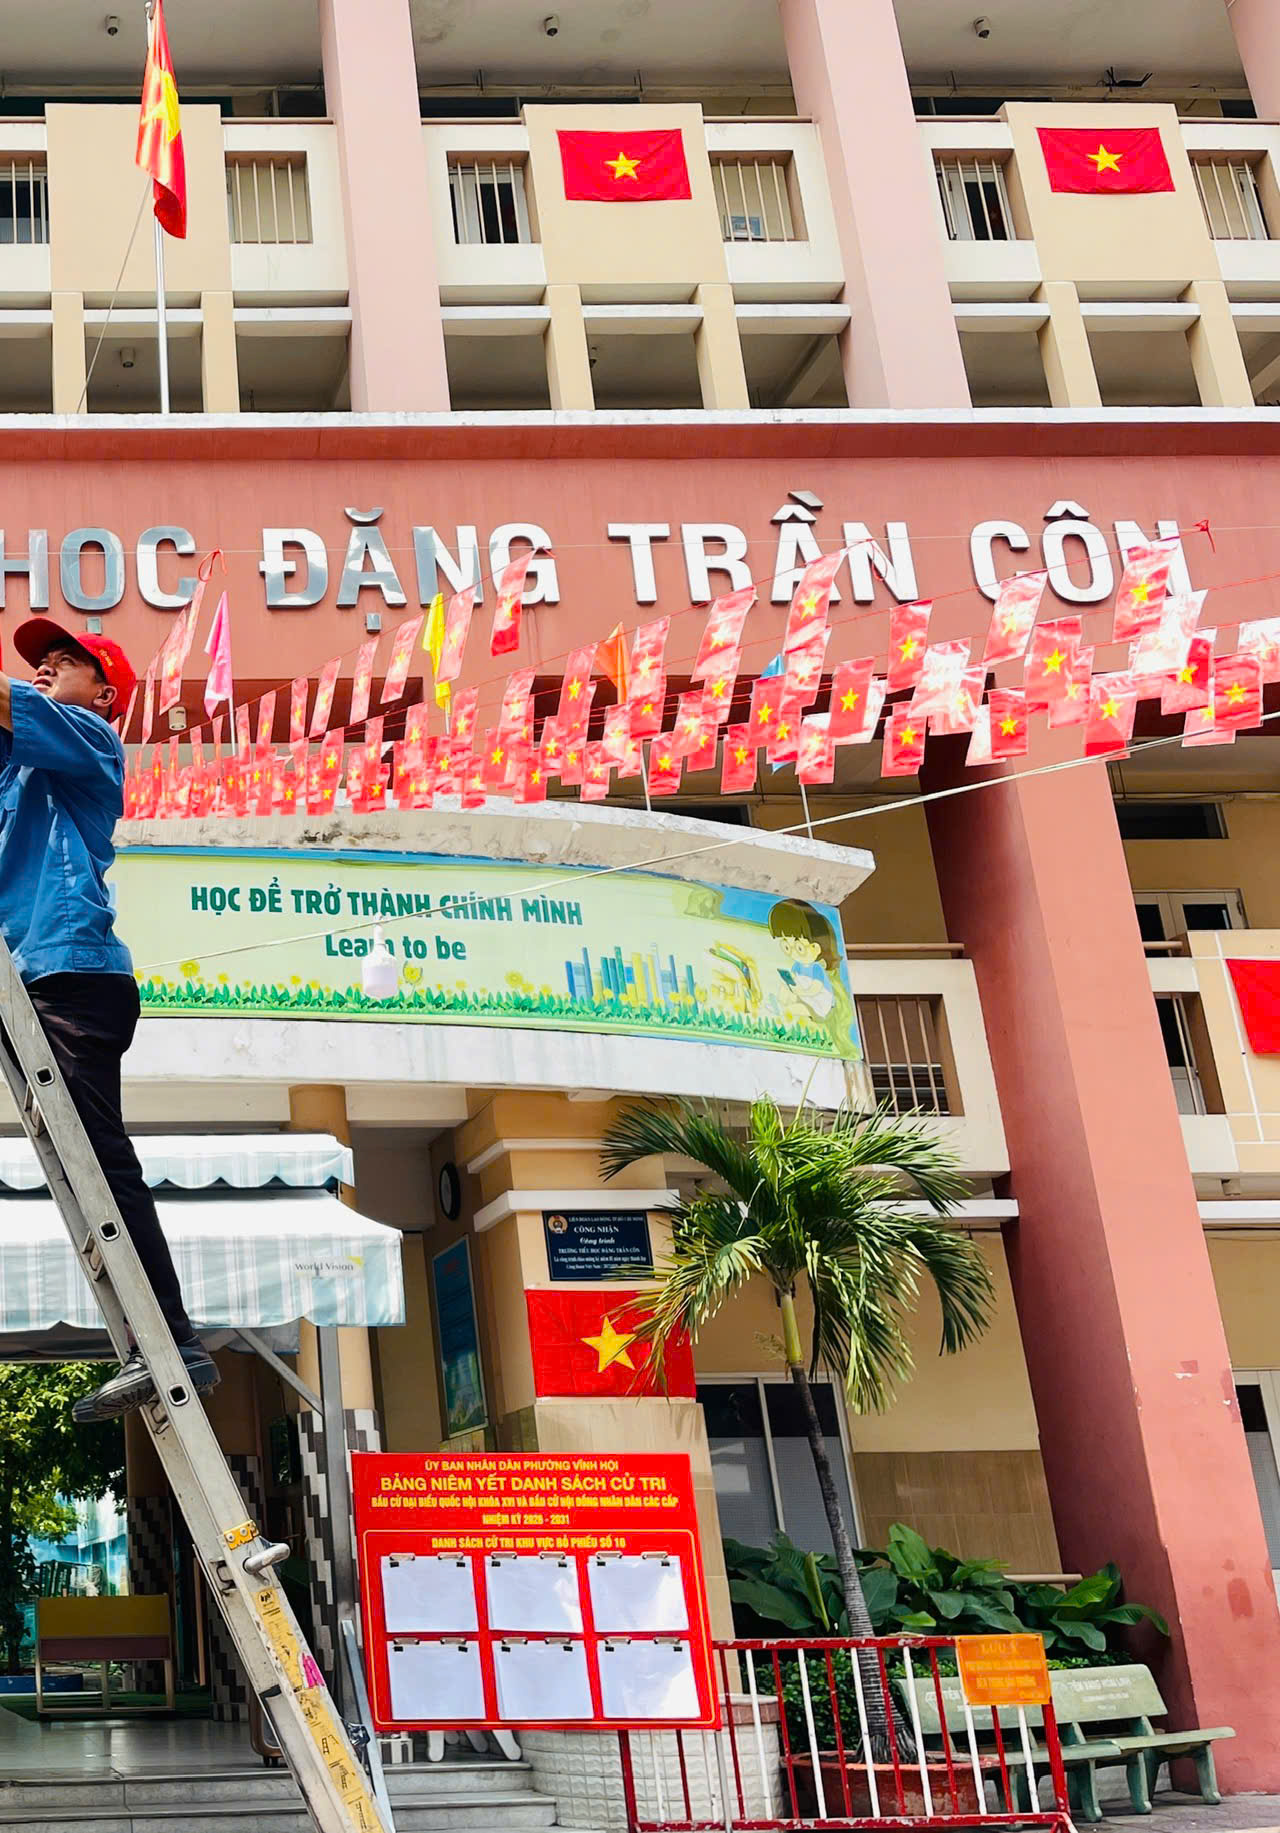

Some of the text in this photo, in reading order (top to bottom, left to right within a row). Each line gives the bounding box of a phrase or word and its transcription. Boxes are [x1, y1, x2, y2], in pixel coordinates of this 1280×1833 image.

[260, 506, 561, 633] ĐẶNG
[607, 489, 918, 606] TRẦN
[191, 877, 583, 925] HỌC ĐỂ TRỞ THÀNH CHÍNH MÌNH
[402, 935, 427, 960] to
[435, 935, 467, 960] be
[325, 1263, 354, 1271] Vision
[441, 1461, 465, 1471] BAN
[467, 1459, 496, 1471] NHÂN
[499, 1459, 521, 1471] DÂN
[523, 1459, 571, 1471] PHƯỜNG
[600, 1460, 619, 1472] HỘI
[380, 1472, 667, 1491] BẢNG NIÊM YẾT DANH SÁCH CỬ TRI
